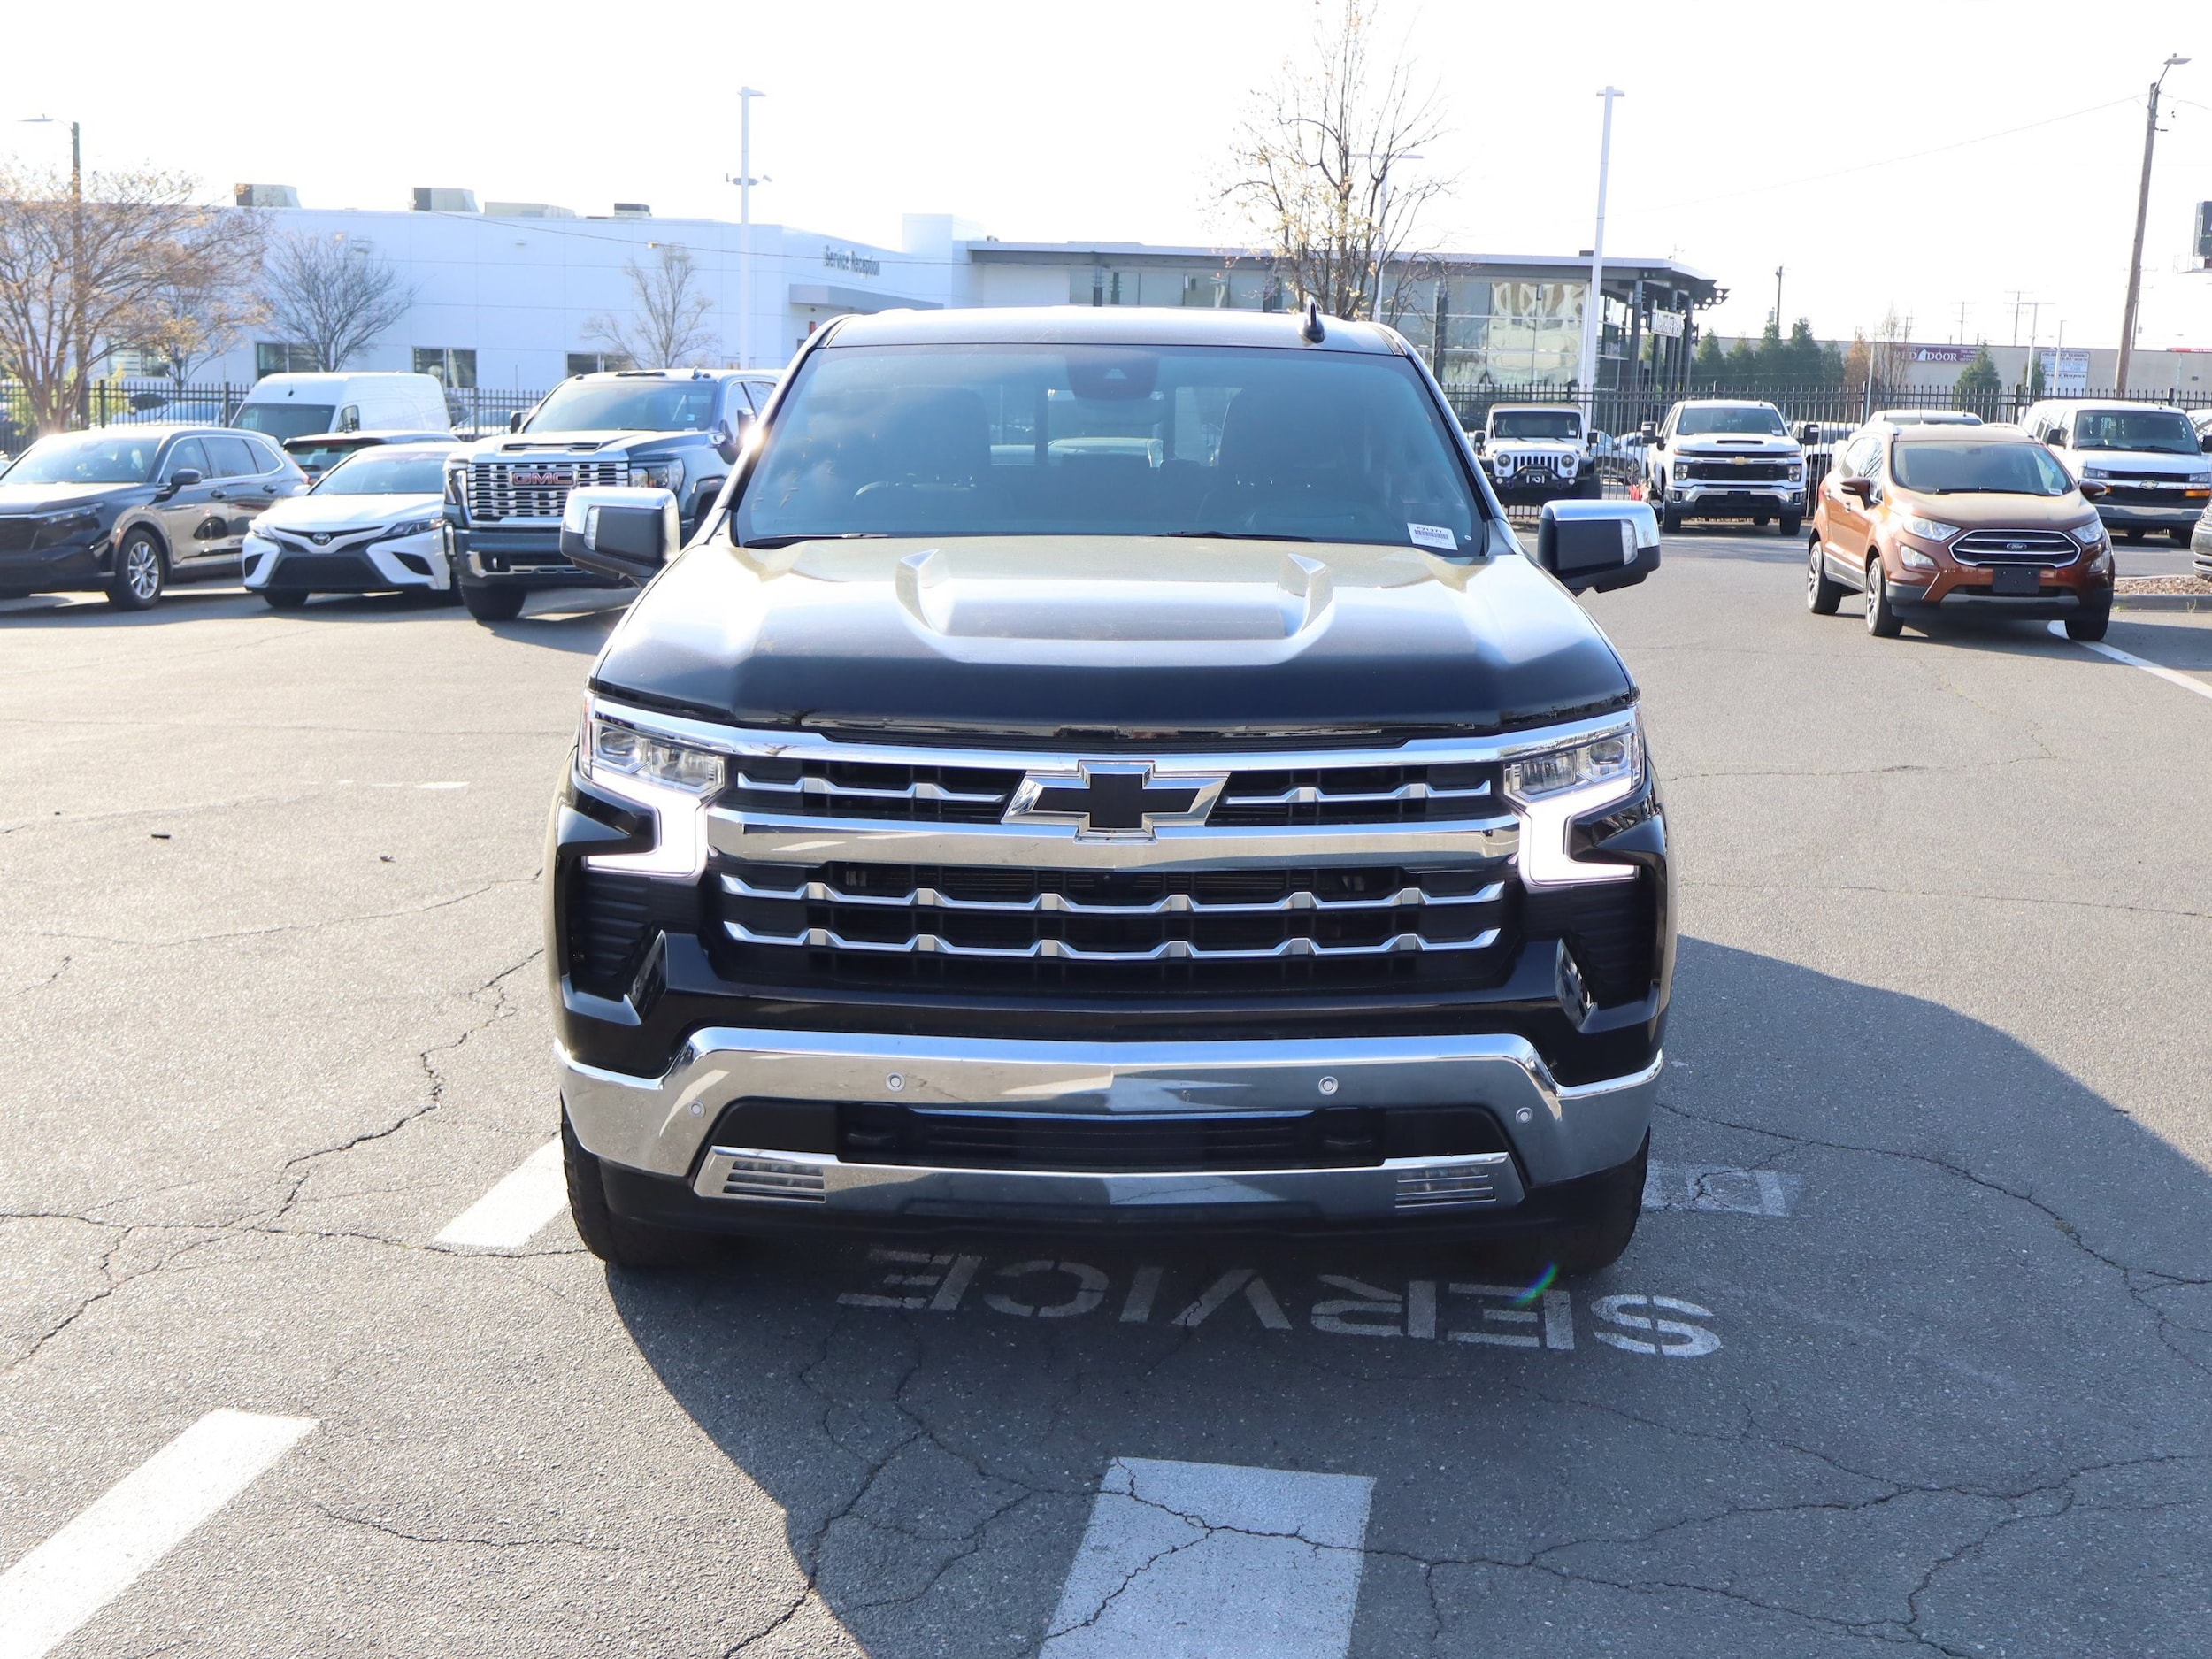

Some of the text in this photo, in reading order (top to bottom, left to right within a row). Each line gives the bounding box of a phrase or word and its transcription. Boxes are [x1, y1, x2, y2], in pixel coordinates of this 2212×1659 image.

[824, 244, 849, 270] Service
[1927, 351, 1957, 362] DOOR
[513, 472, 572, 485] GMC
[836, 1248, 1722, 1357] SERVICE
